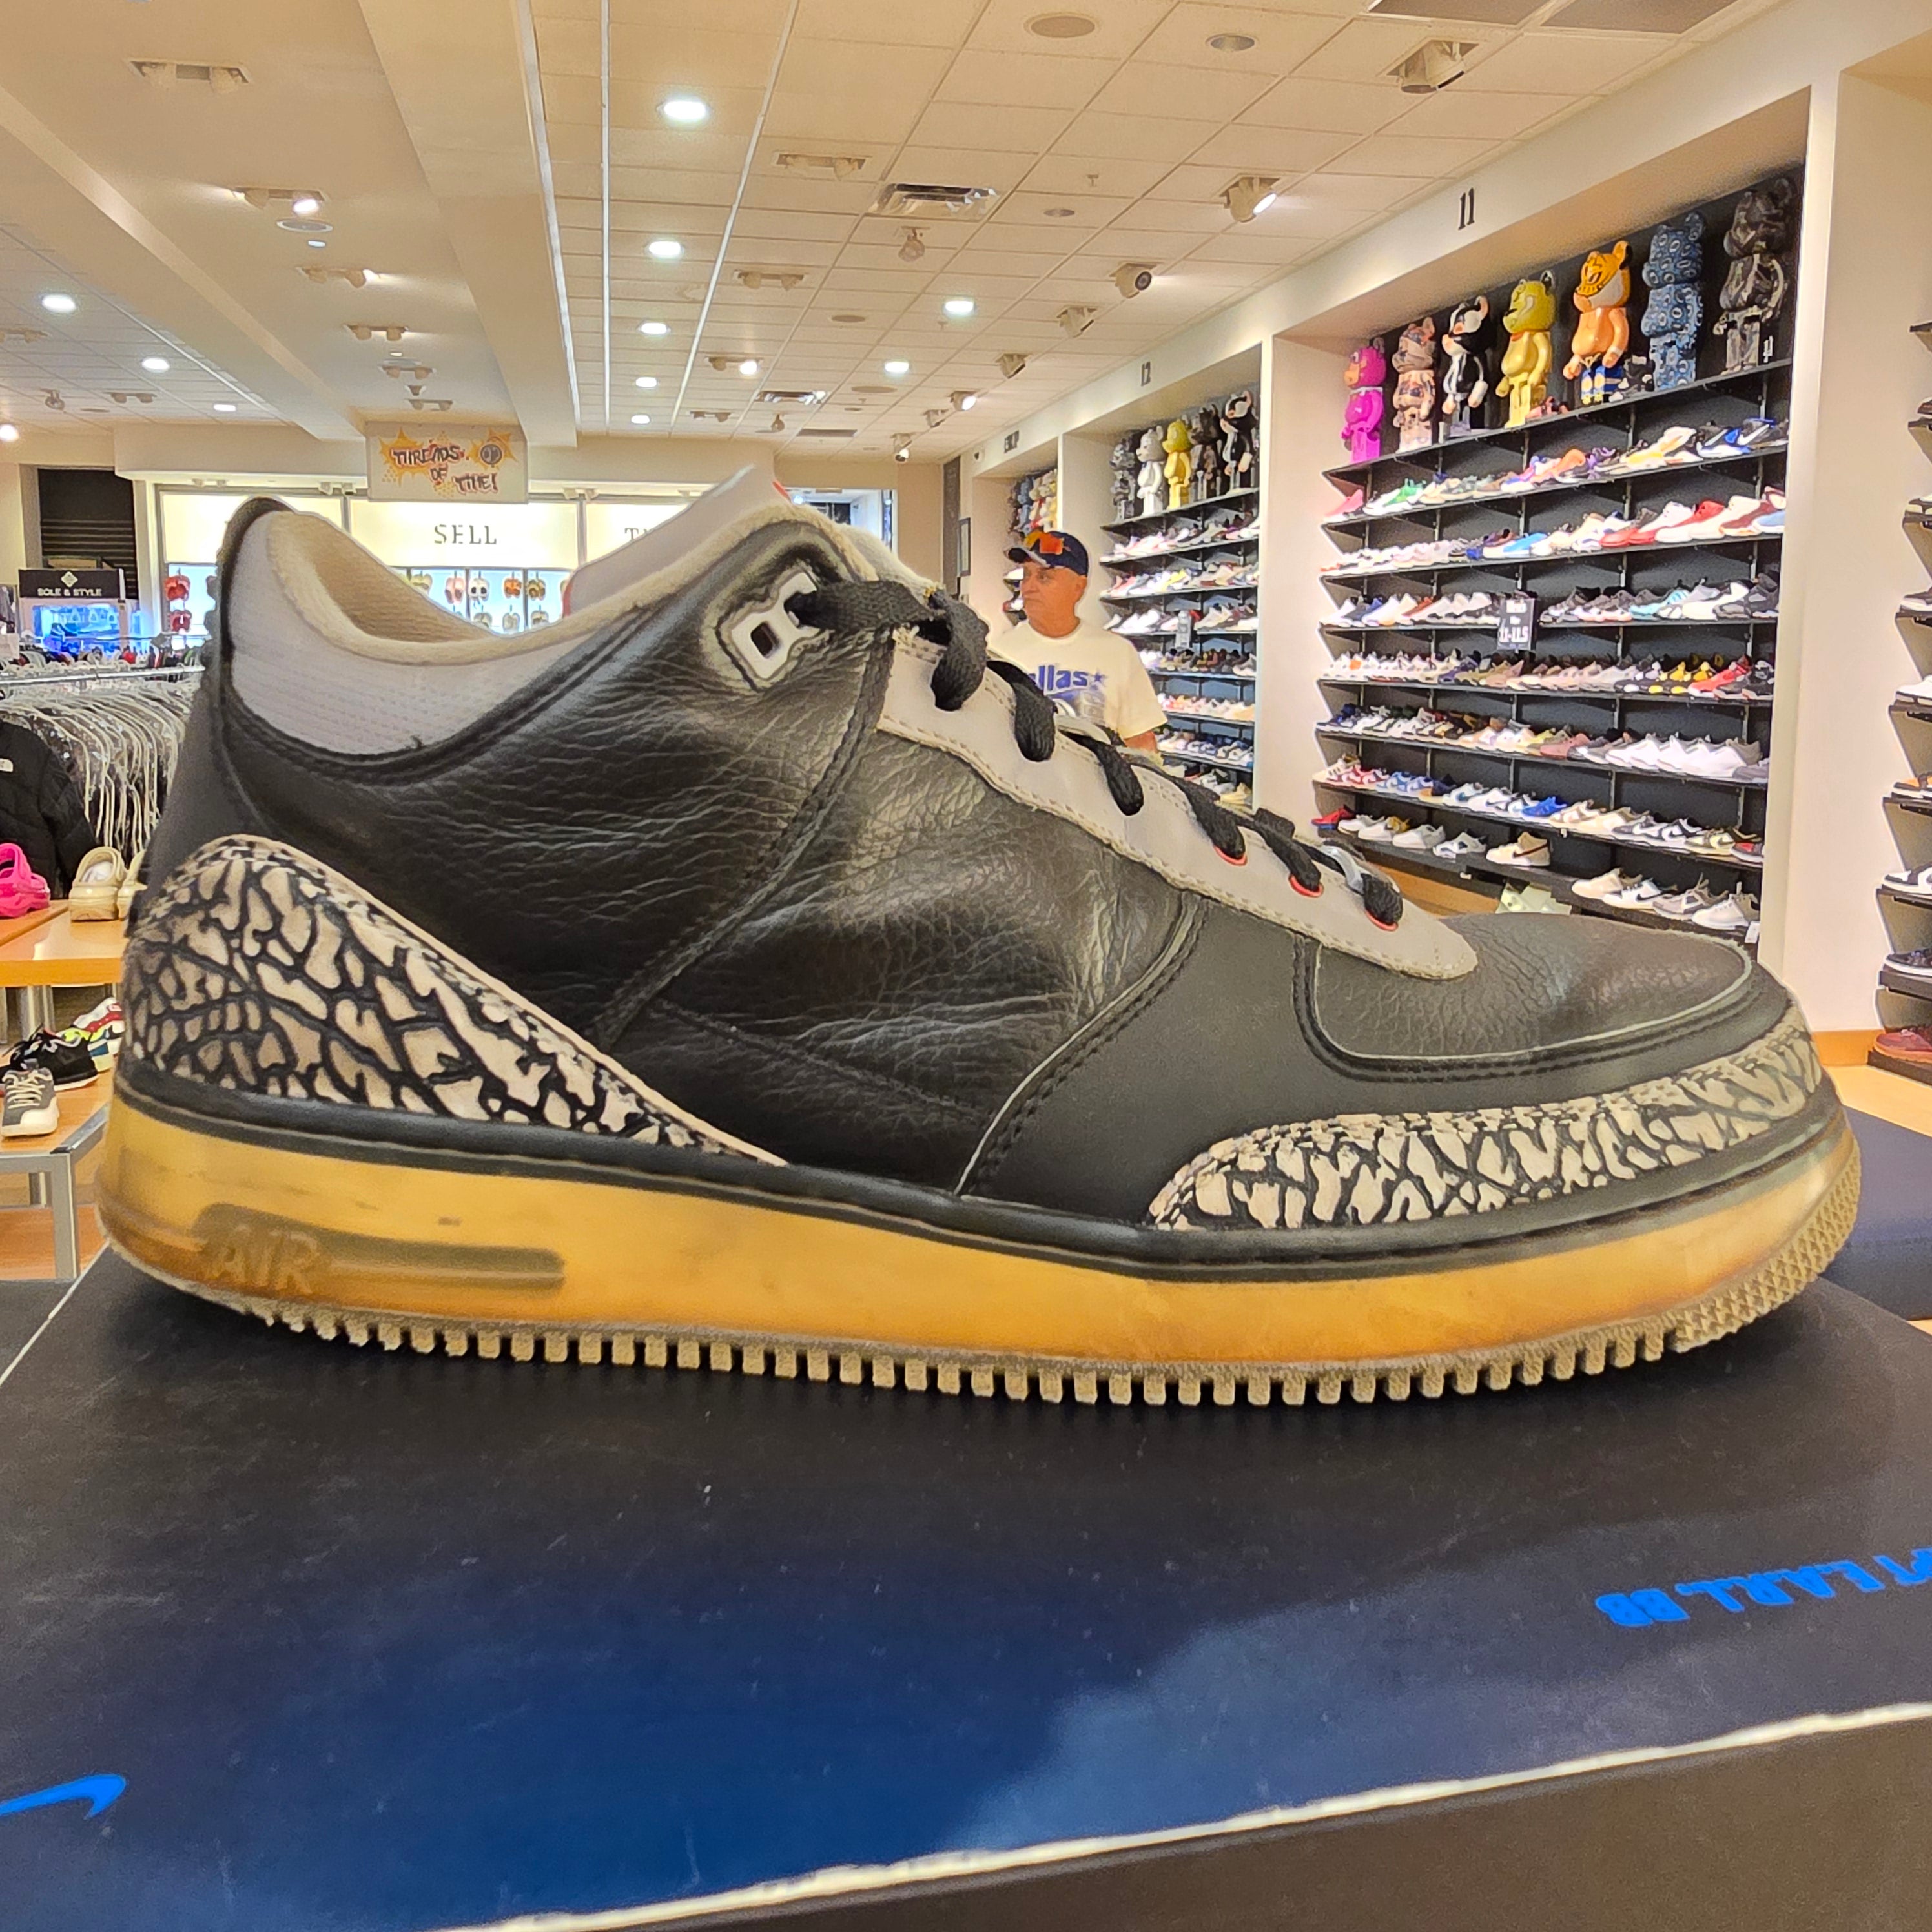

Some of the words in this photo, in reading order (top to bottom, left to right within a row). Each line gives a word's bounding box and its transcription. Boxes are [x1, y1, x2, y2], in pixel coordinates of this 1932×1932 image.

[1458, 187, 1475, 231] 11
[434, 524, 497, 545] SELL
[1028, 664, 1089, 691] llas
[204, 1225, 315, 1295] AIR
